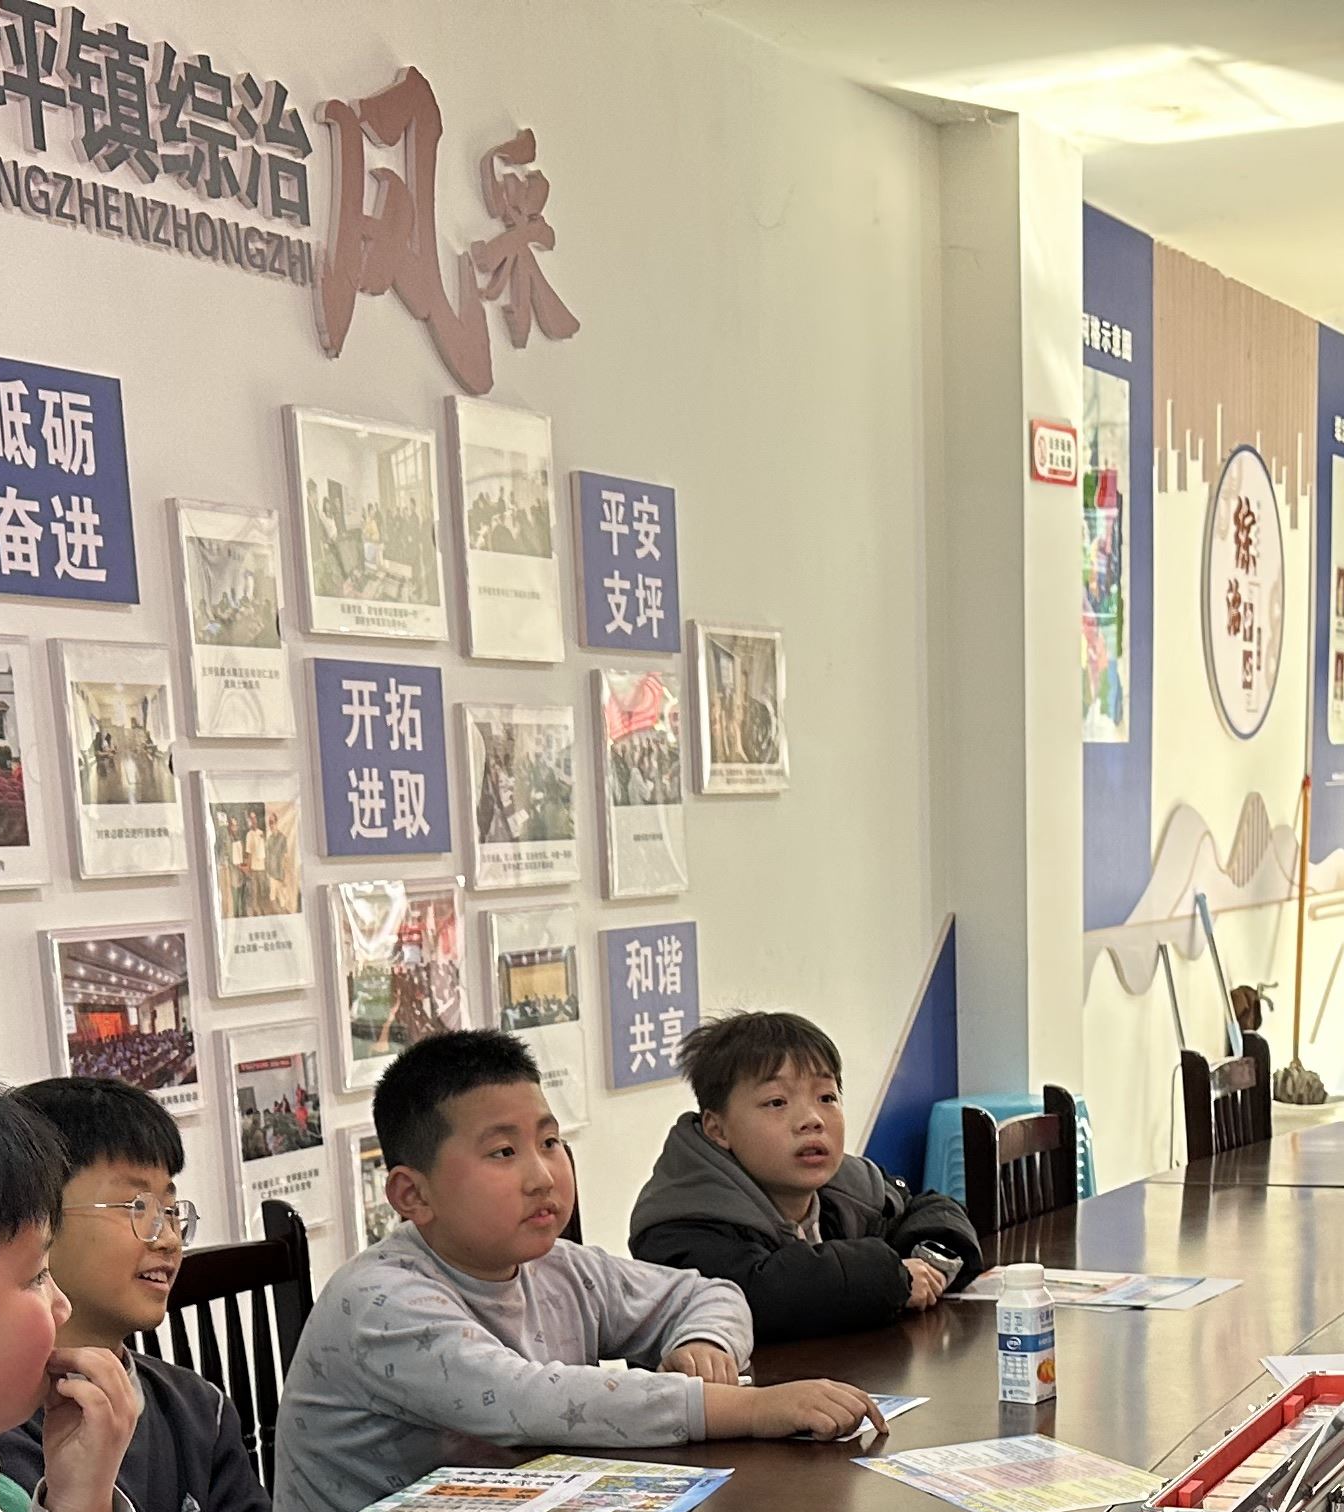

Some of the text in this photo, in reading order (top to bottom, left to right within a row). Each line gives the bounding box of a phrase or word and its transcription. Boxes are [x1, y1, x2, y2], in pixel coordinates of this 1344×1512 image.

[599, 487, 662, 564] 平安
[602, 570, 665, 641] 支坪
[340, 678, 425, 756] 开拓
[348, 767, 432, 843] 进取
[624, 935, 683, 1002] 和谐
[627, 1009, 684, 1078] 共享
